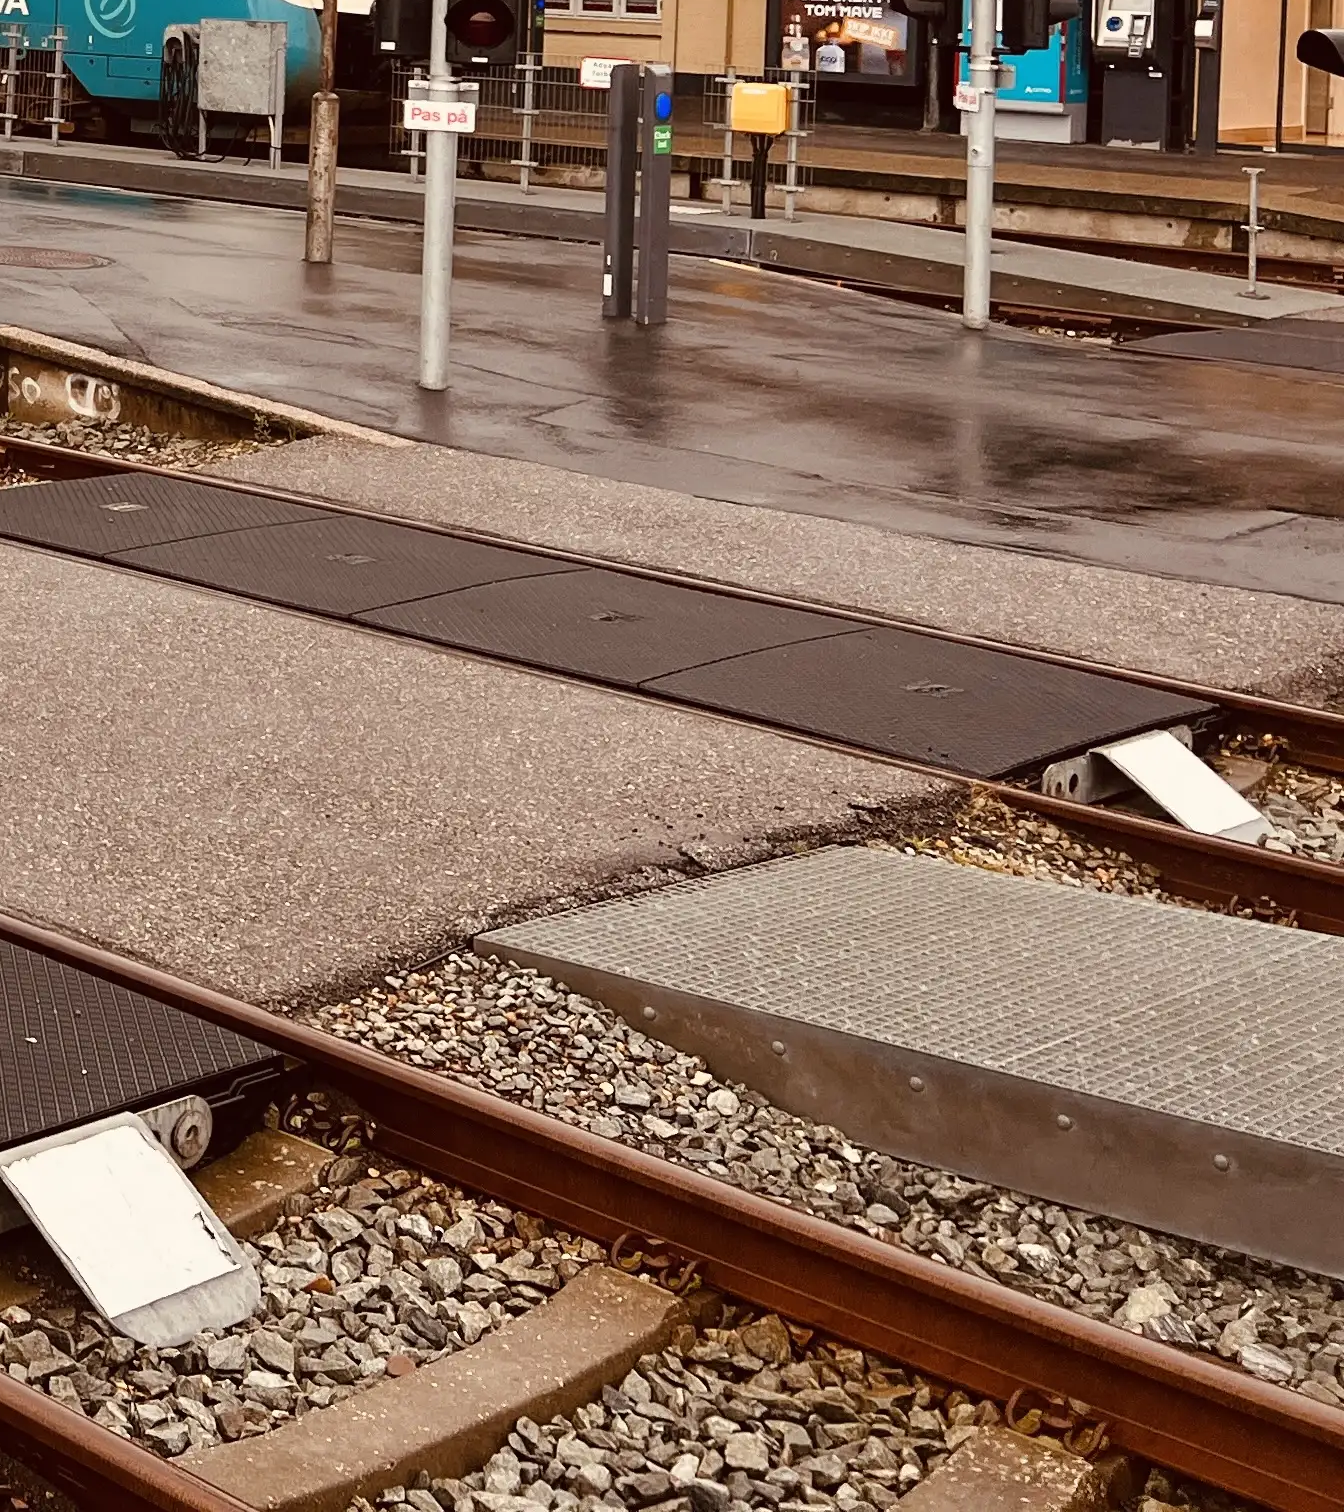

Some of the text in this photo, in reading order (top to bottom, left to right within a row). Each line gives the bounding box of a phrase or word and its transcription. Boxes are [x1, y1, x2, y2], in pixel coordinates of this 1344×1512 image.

[804, 3, 883, 19] TOM MAVE
[411, 107, 468, 126] Pas på
